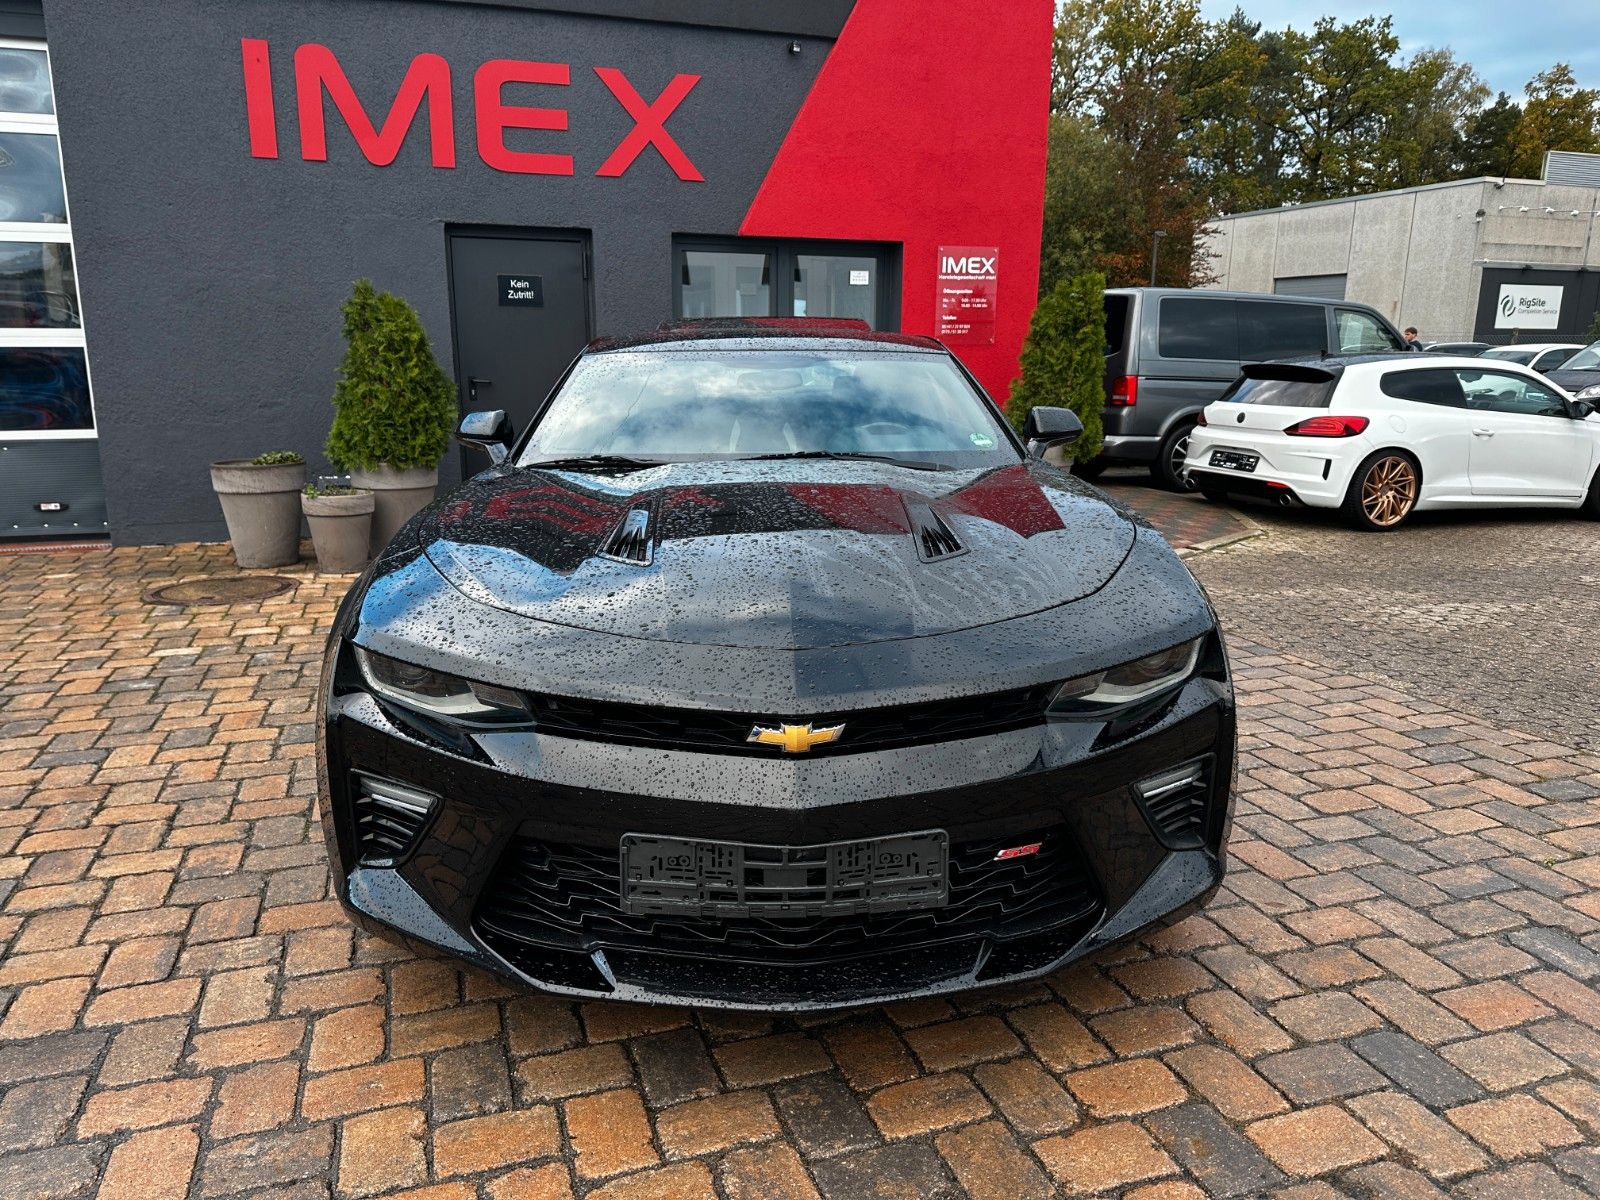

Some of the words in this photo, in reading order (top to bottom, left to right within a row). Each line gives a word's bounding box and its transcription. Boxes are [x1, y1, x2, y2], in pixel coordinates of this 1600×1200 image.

[241, 38, 705, 181] IMEX
[942, 256, 995, 274] IMEX
[510, 279, 529, 288] Kein
[507, 290, 534, 299] Zutritt!
[1519, 297, 1546, 309] RigSite
